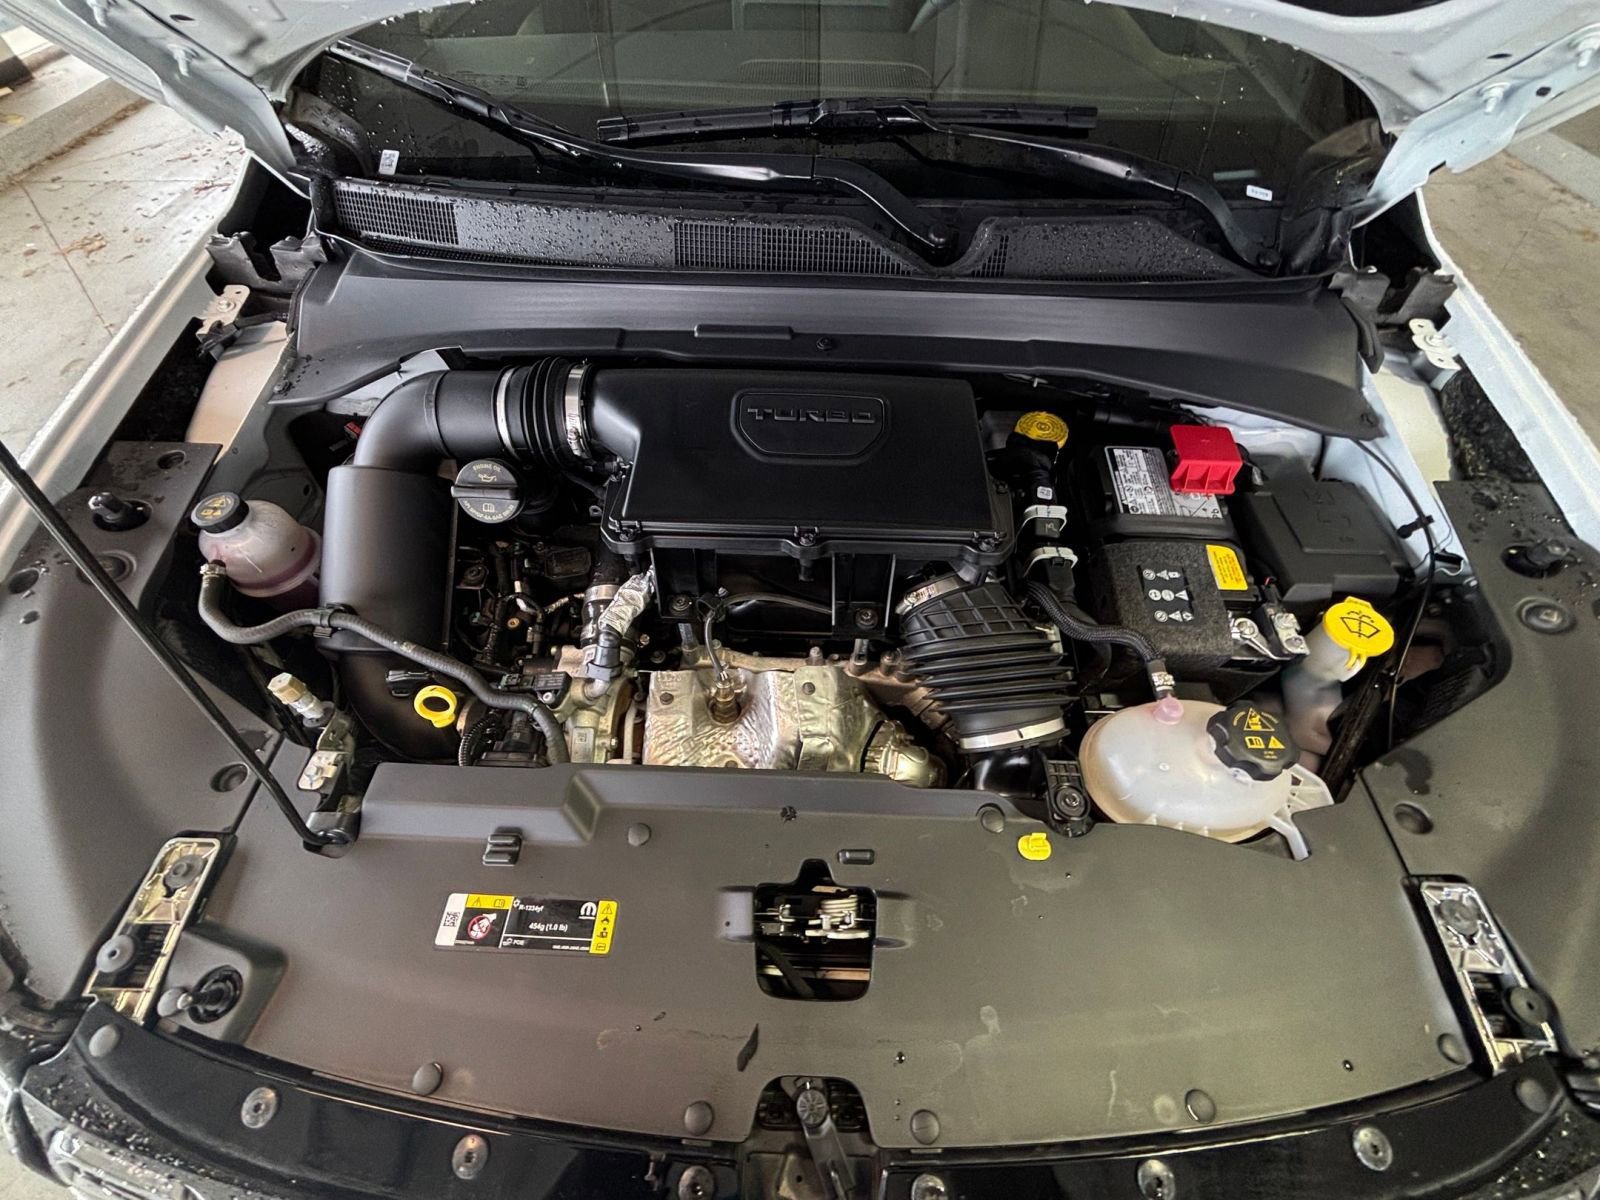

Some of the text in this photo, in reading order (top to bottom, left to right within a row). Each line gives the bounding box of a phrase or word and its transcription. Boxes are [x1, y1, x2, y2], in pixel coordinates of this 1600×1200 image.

[747, 408, 875, 423] TURBO
[528, 922, 569, 933] 454g (1.0 lb)
